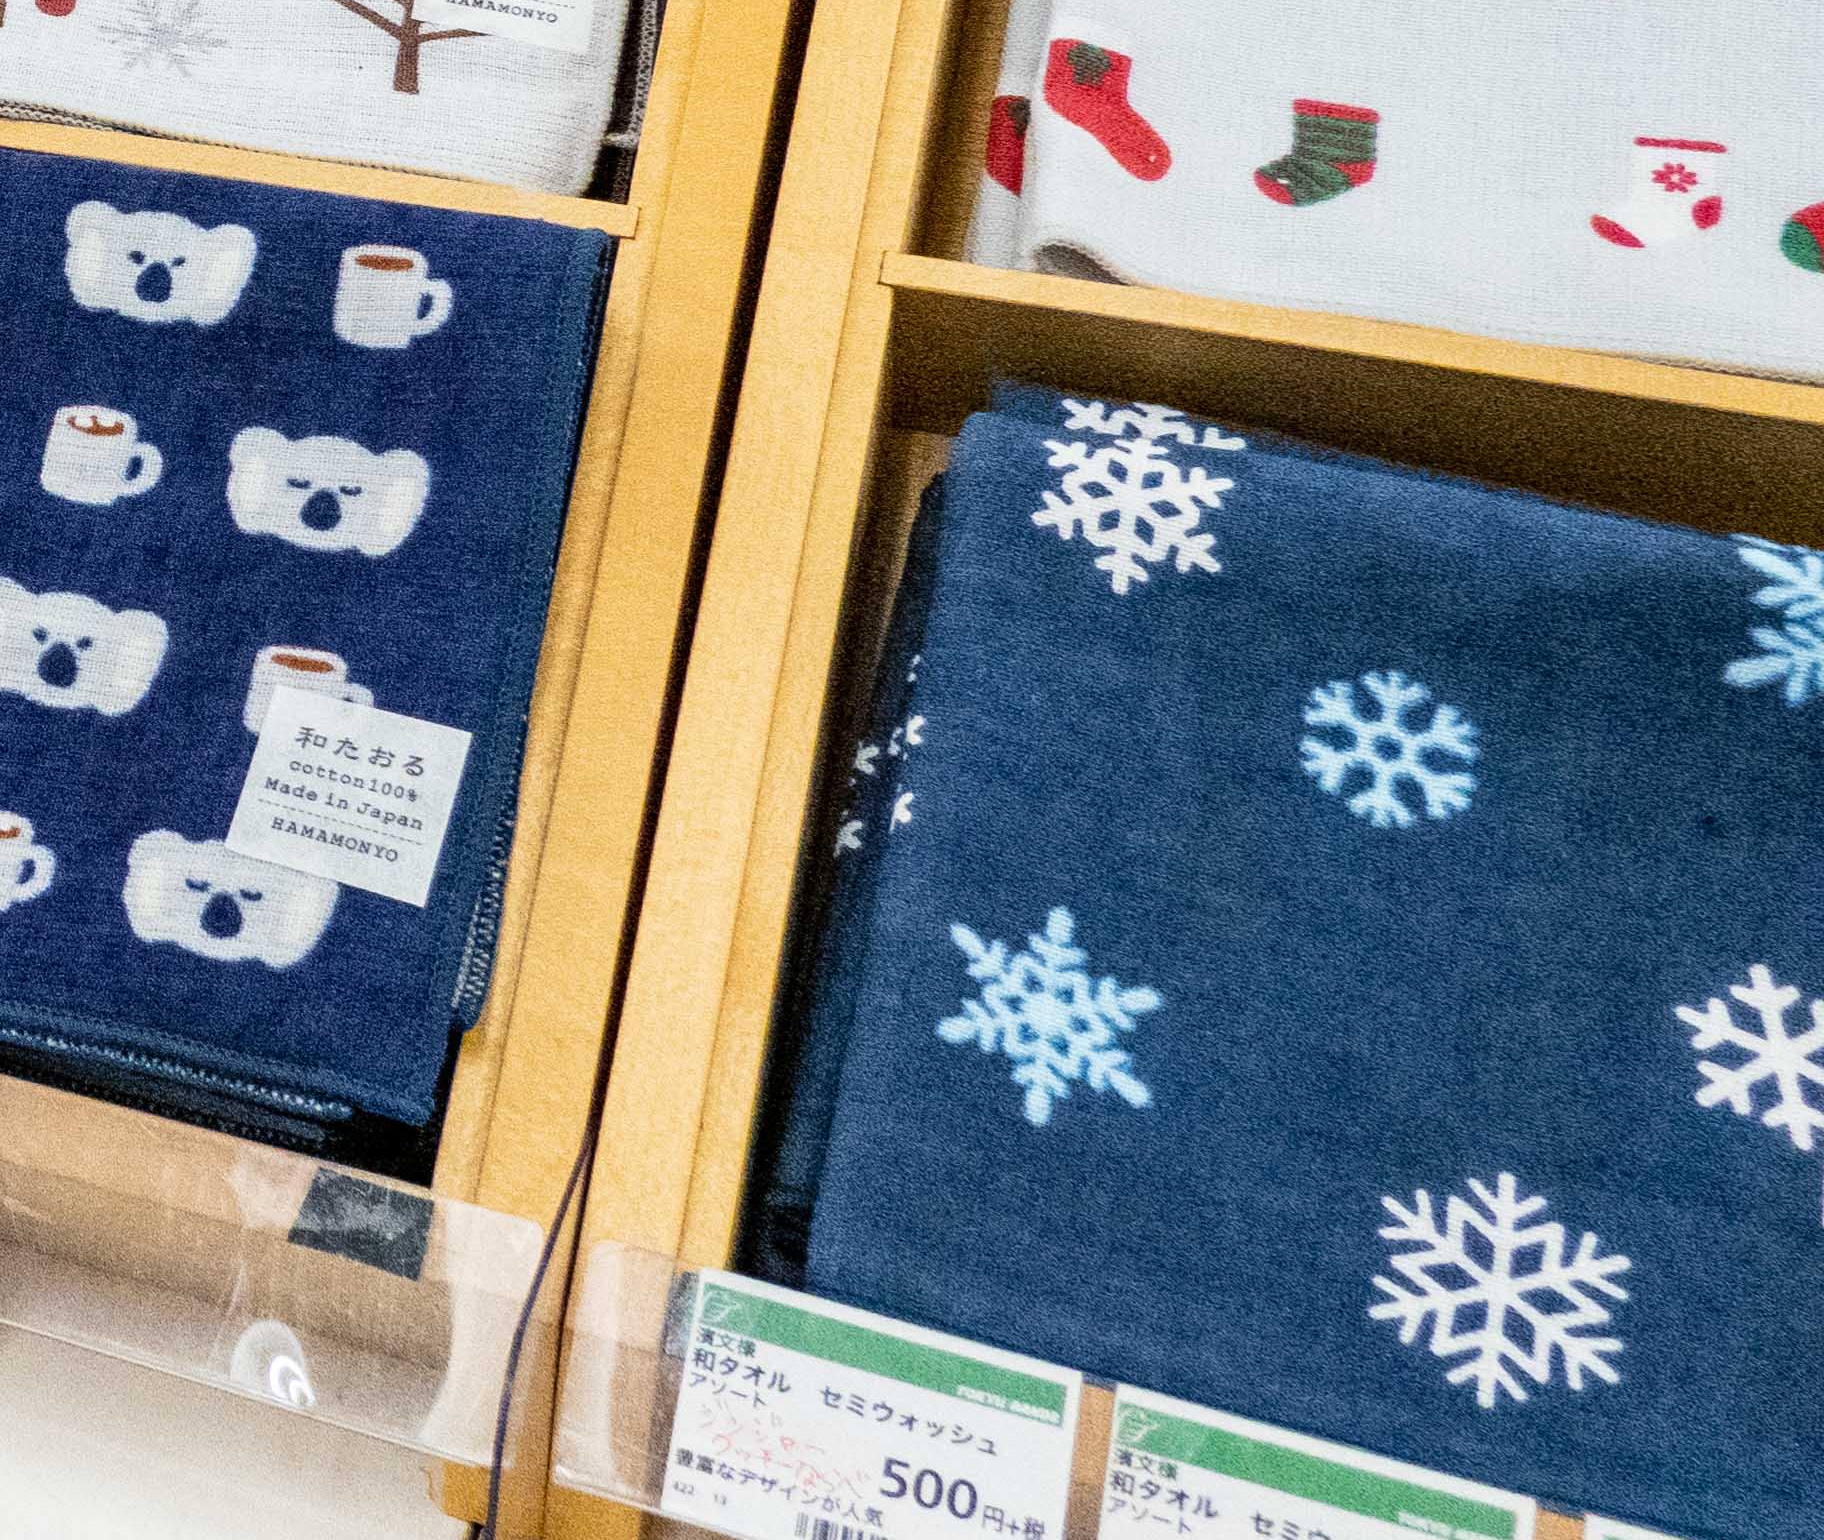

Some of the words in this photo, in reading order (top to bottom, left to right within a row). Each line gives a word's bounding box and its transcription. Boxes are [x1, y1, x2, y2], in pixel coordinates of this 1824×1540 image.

[295, 726, 424, 777] 和たおる
[264, 777, 317, 801] Made
[325, 794, 349, 810] in
[357, 803, 422, 830] Japan
[290, 760, 418, 802] cotton100%
[272, 817, 399, 862] HAMAMONYO
[692, 1347, 790, 1392] 和タオル
[820, 1386, 996, 1455] セミウォッシュ
[1111, 1470, 1218, 1520] 和タオル
